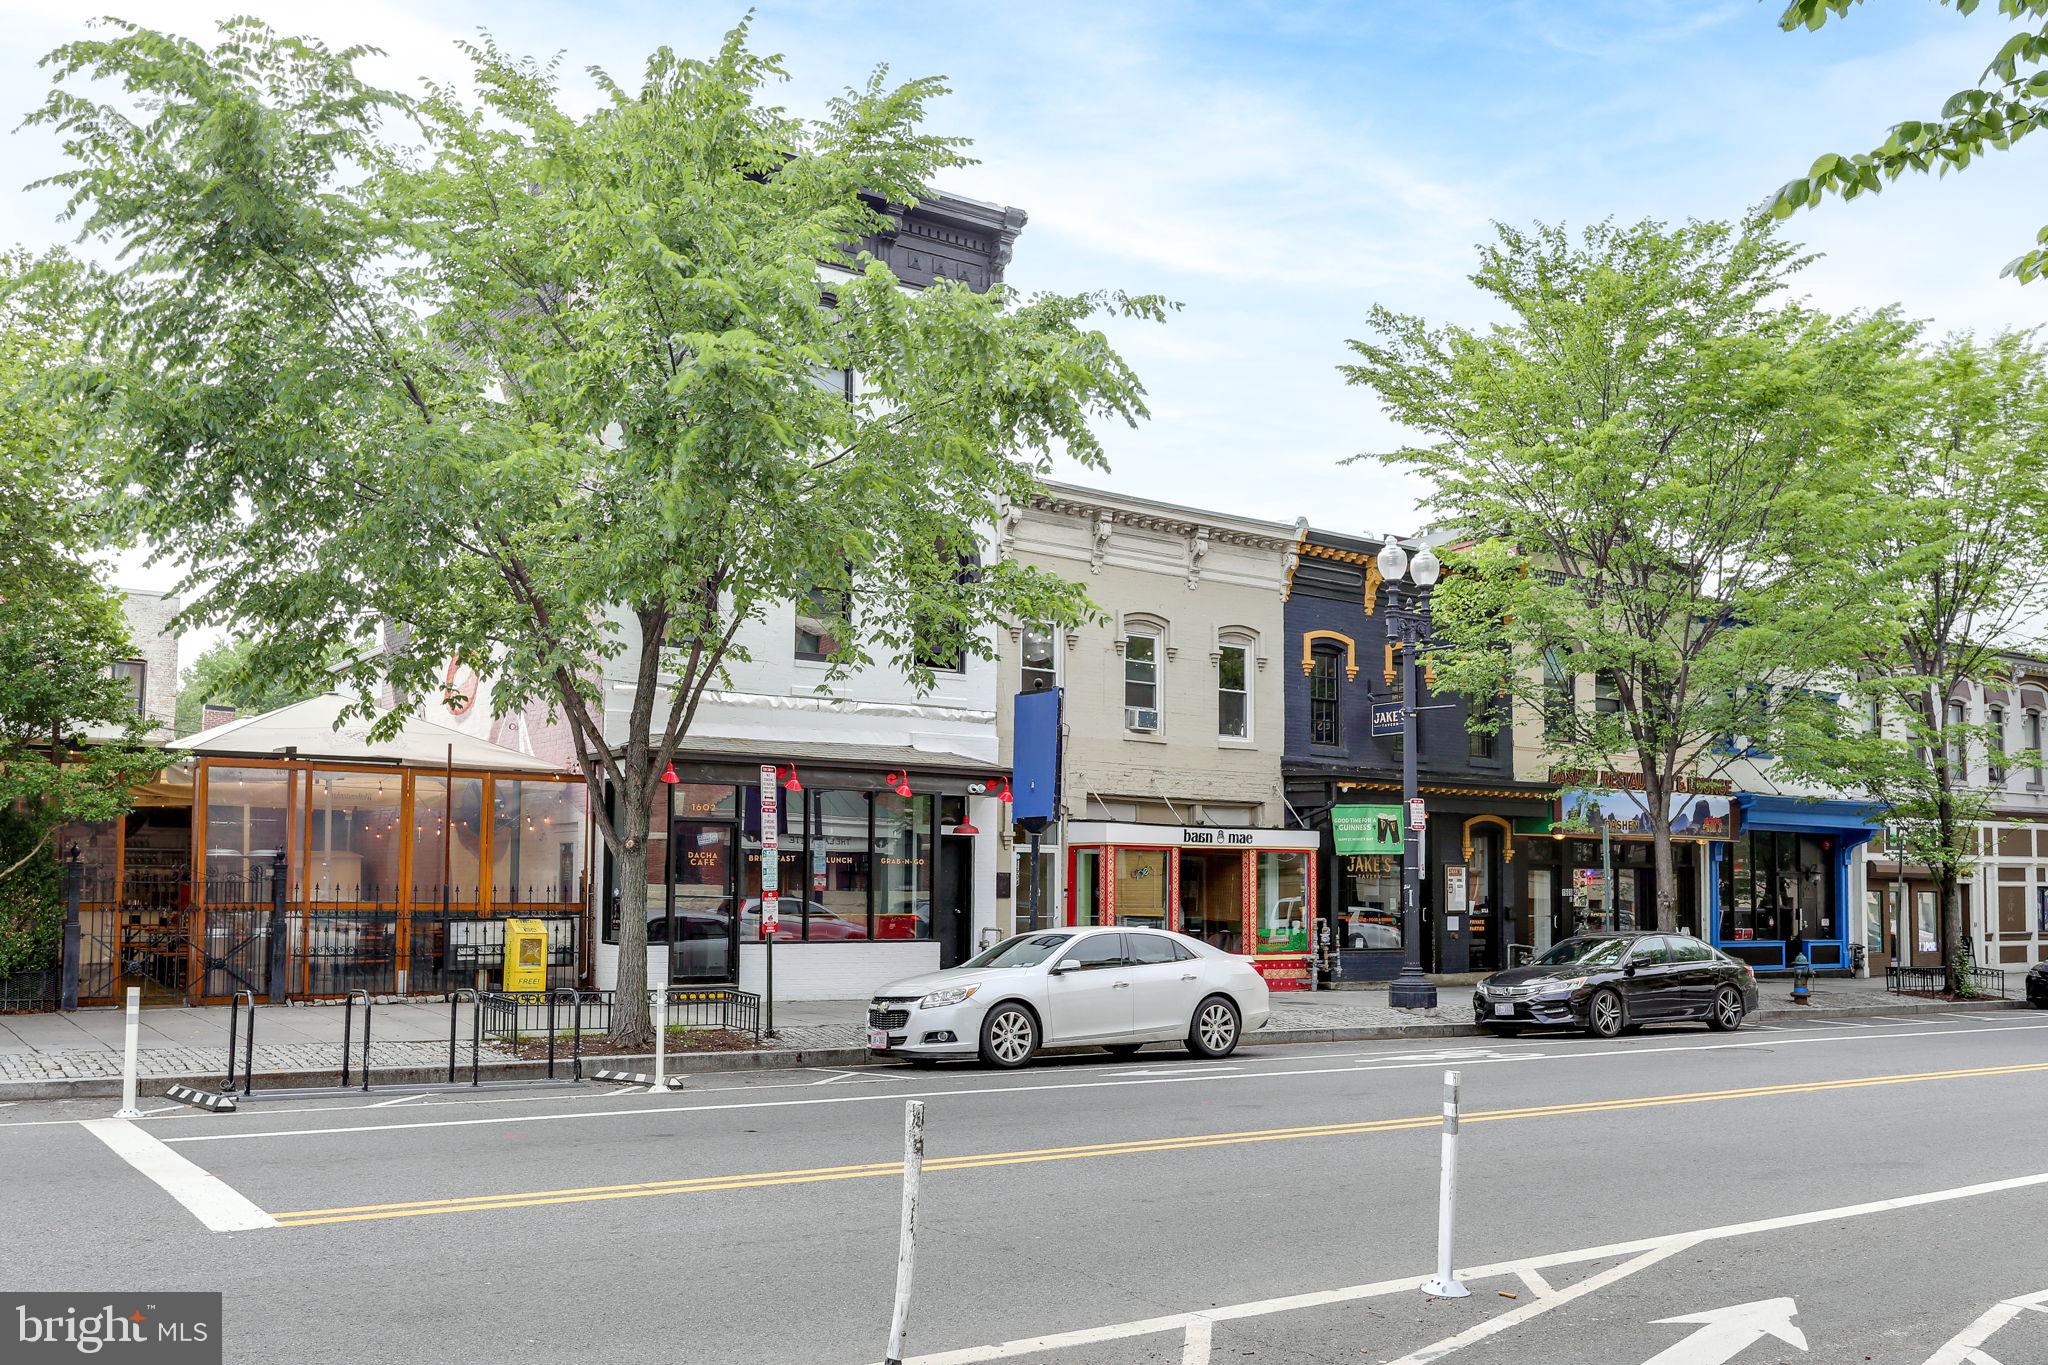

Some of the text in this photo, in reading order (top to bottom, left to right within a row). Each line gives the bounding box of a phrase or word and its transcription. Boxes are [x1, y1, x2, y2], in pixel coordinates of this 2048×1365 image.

[692, 803, 716, 812] 1602
[1605, 820, 1639, 830] DASHEN
[1228, 833, 1253, 844] mae
[687, 851, 718, 859] DACHA
[690, 858, 715, 866] CAFE
[1347, 856, 1392, 873] JAKE'S
